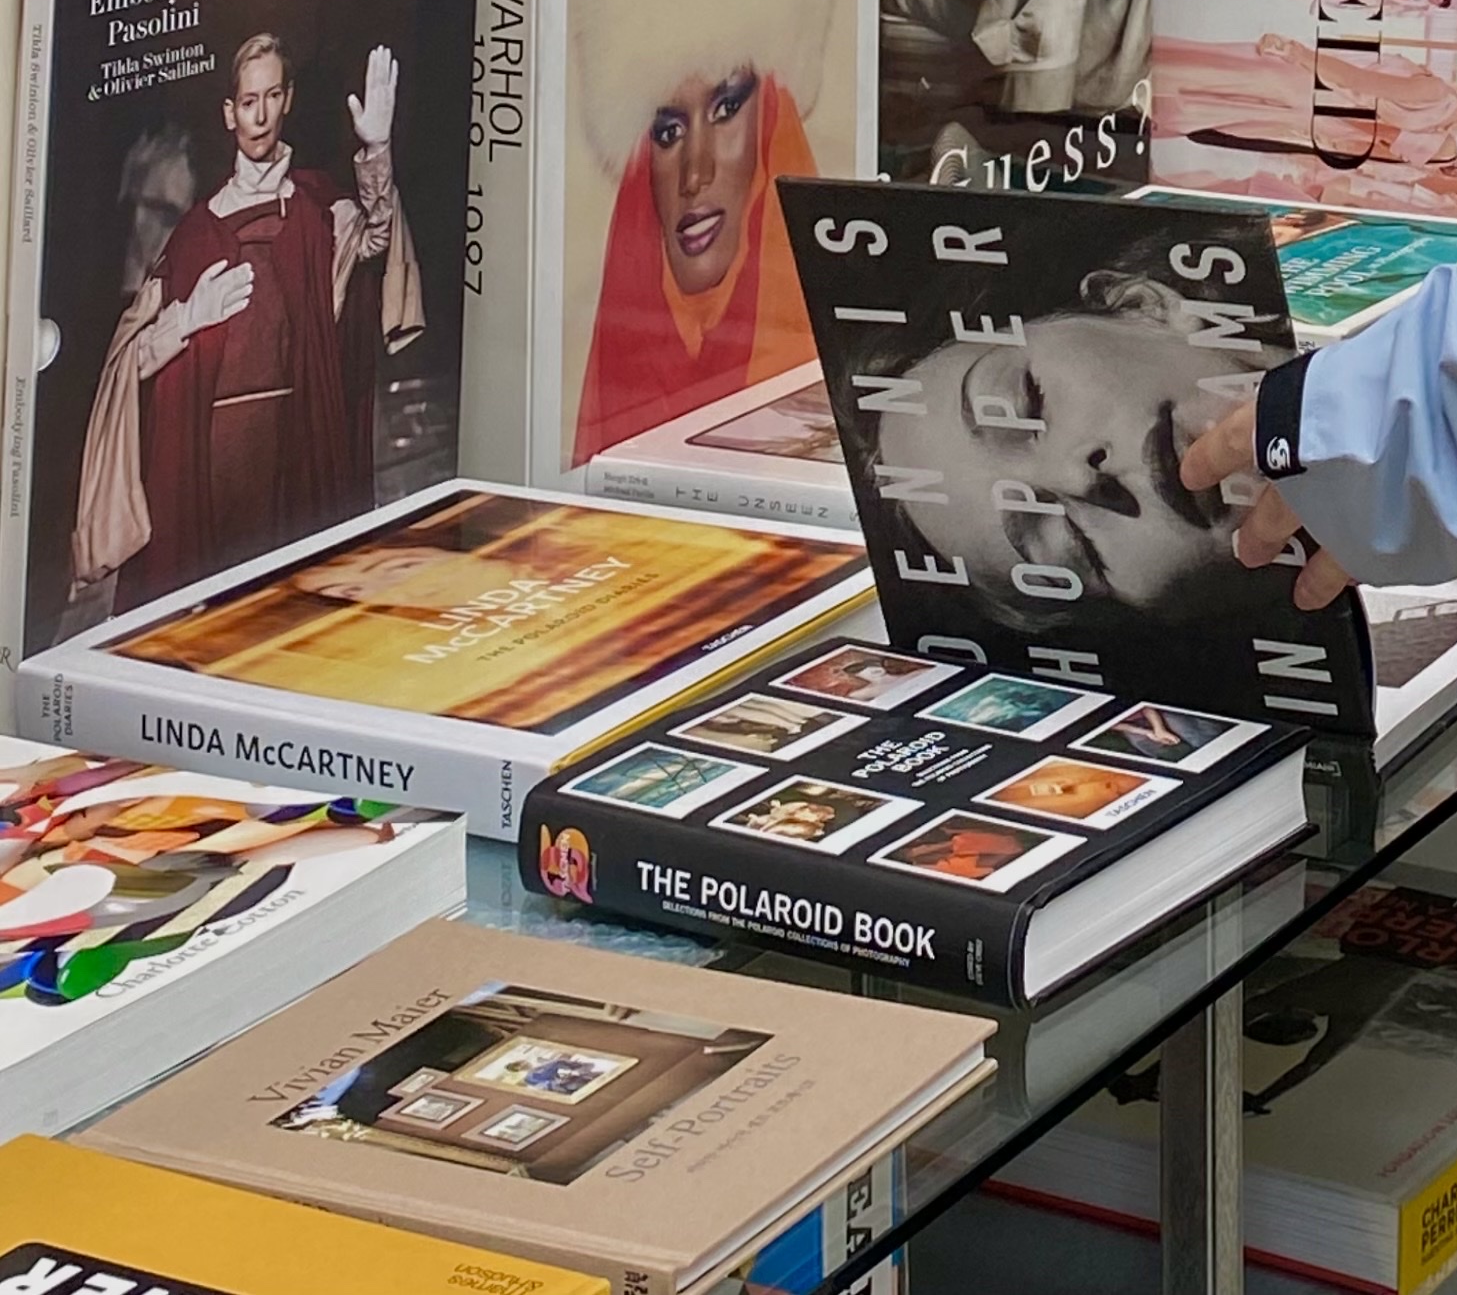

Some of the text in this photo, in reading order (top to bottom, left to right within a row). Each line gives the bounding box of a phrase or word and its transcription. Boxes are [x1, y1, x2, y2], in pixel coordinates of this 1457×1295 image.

[30, 24, 42, 59] Tilda
[108, 1, 201, 47] Pasolini
[28, 61, 40, 121] Swinton
[88, 54, 216, 101] & Olivier Saillard
[101, 43, 205, 80] Tilda Swinton
[24, 137, 38, 187] Olivier
[812, 217, 988, 665] DENNIS
[932, 224, 1106, 687] HOPPER
[738, 494, 829, 519] UNSEEN
[403, 555, 633, 665] McCARTNEY
[419, 575, 550, 632] LINDA
[52, 673, 64, 742] POLAROID
[1252, 638, 1339, 717] IN
[64, 685, 74, 736] DIARIES
[140, 713, 415, 792] LINDA McCARTNEY
[851, 731, 947, 778] POLAROID
[856, 740, 903, 760] THE
[891, 745, 950, 773] BOOK
[502, 760, 513, 829] TASCHEN
[636, 860, 692, 902] THE
[700, 874, 844, 937] POLAROID
[853, 910, 937, 960] BOOK
[95, 886, 308, 1000] Charlotte Cotton
[248, 984, 456, 1106] Vivian Maier
[605, 1052, 803, 1183] Self-Portraits
